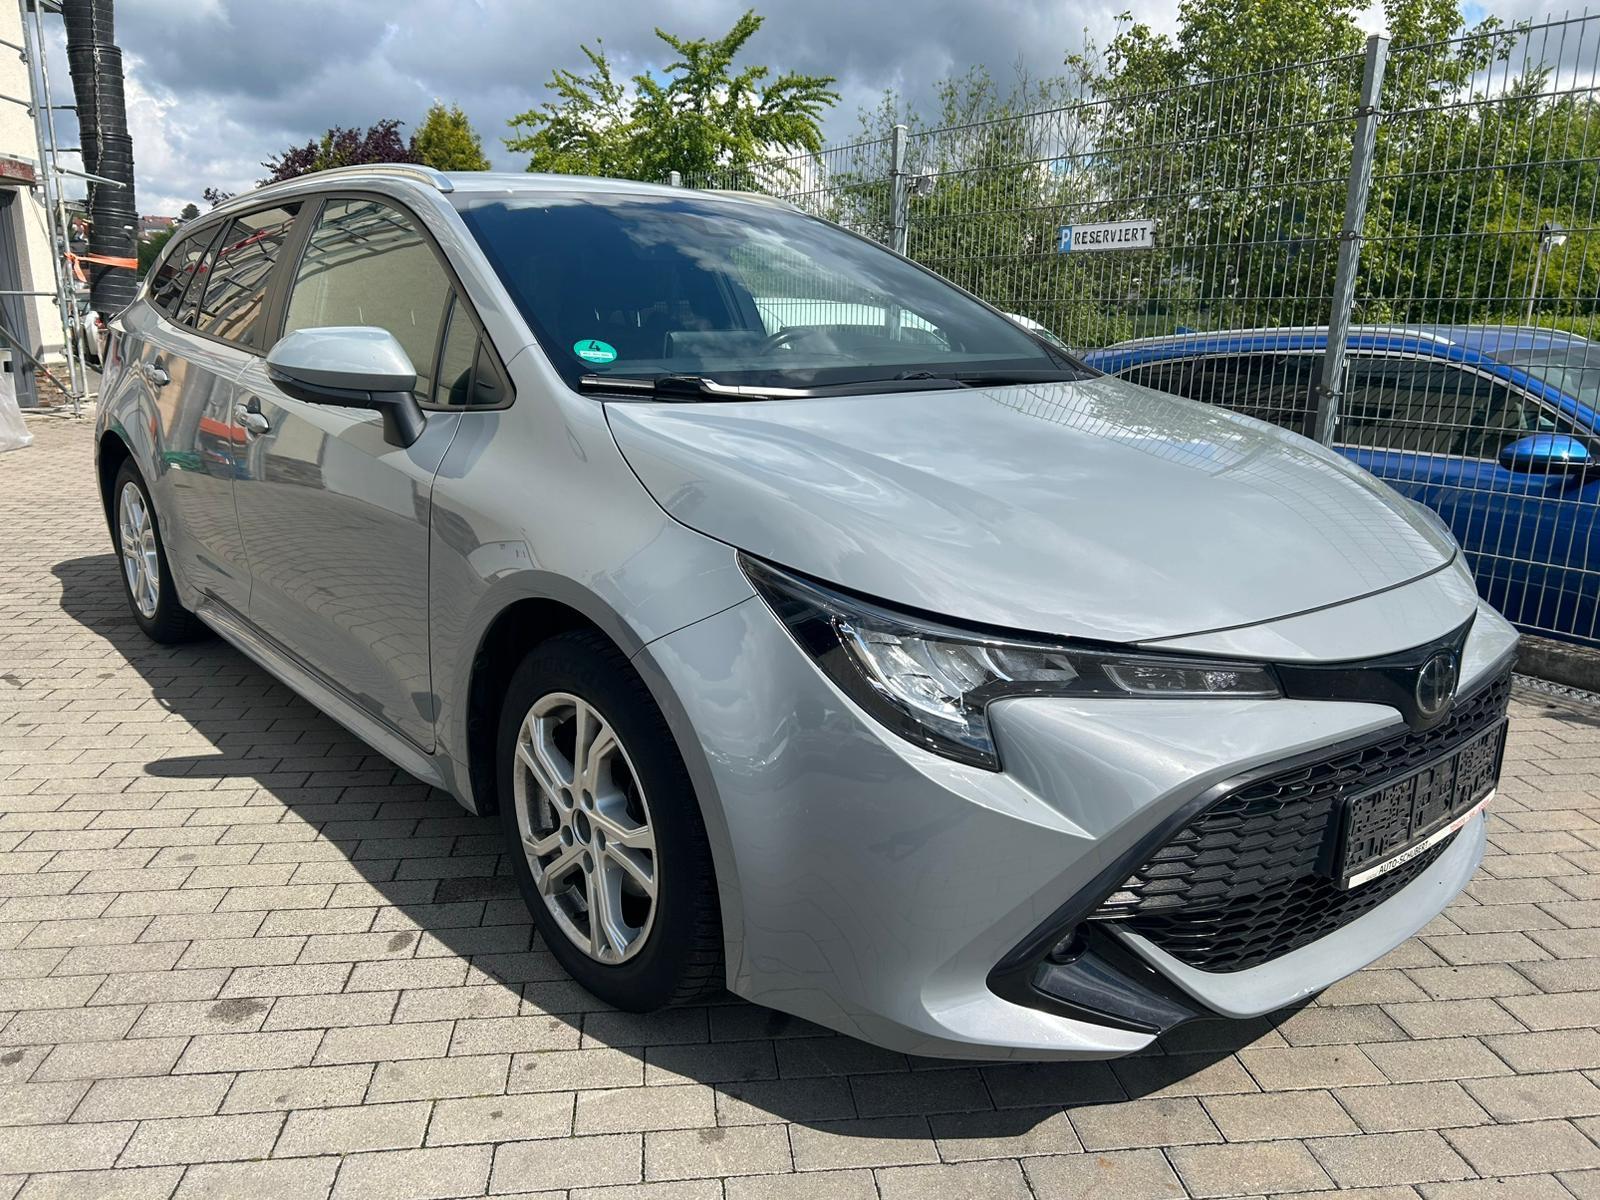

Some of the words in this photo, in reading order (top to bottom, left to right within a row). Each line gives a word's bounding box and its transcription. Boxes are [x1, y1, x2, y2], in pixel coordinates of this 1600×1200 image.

[1061, 229, 1070, 249] P
[1074, 227, 1147, 245] RESERVIERT
[588, 340, 601, 352] 4
[1378, 840, 1429, 875] AUTO-SCHUBERT
